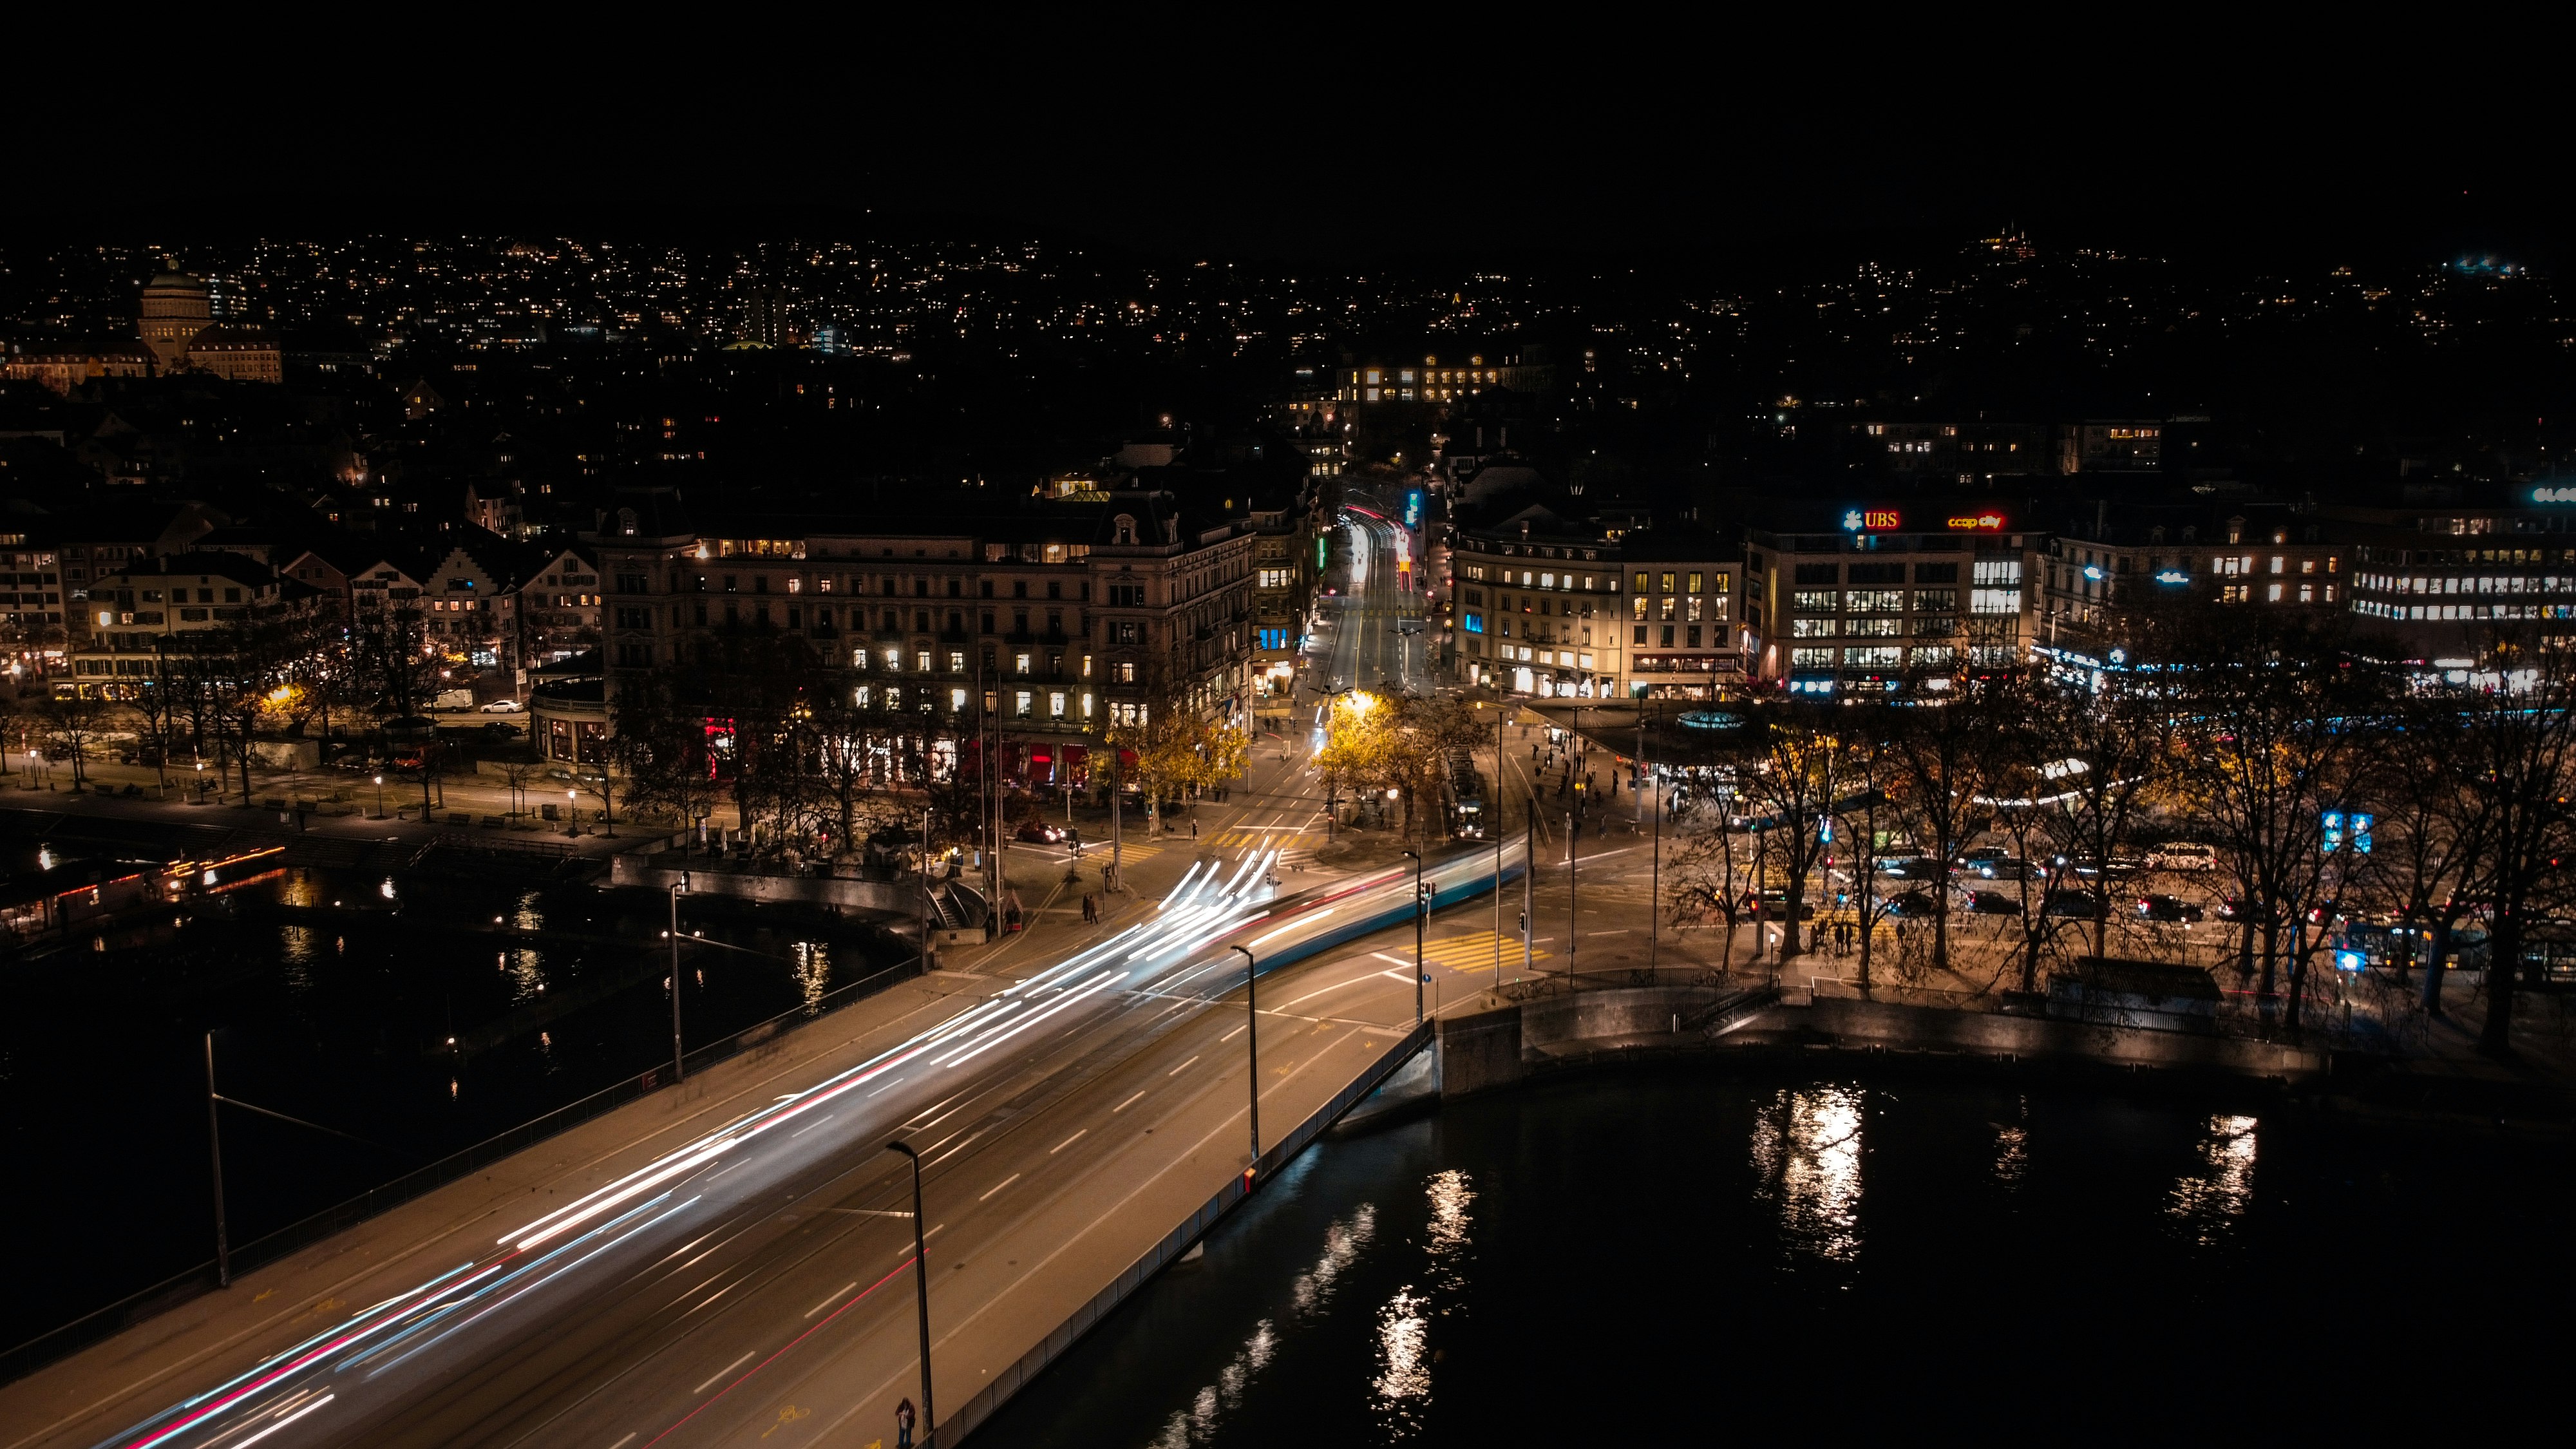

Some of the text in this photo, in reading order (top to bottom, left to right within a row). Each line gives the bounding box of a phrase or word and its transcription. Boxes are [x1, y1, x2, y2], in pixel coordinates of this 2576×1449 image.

[1865, 513, 1897, 527] UBS
[1948, 515, 2001, 529] coop city
